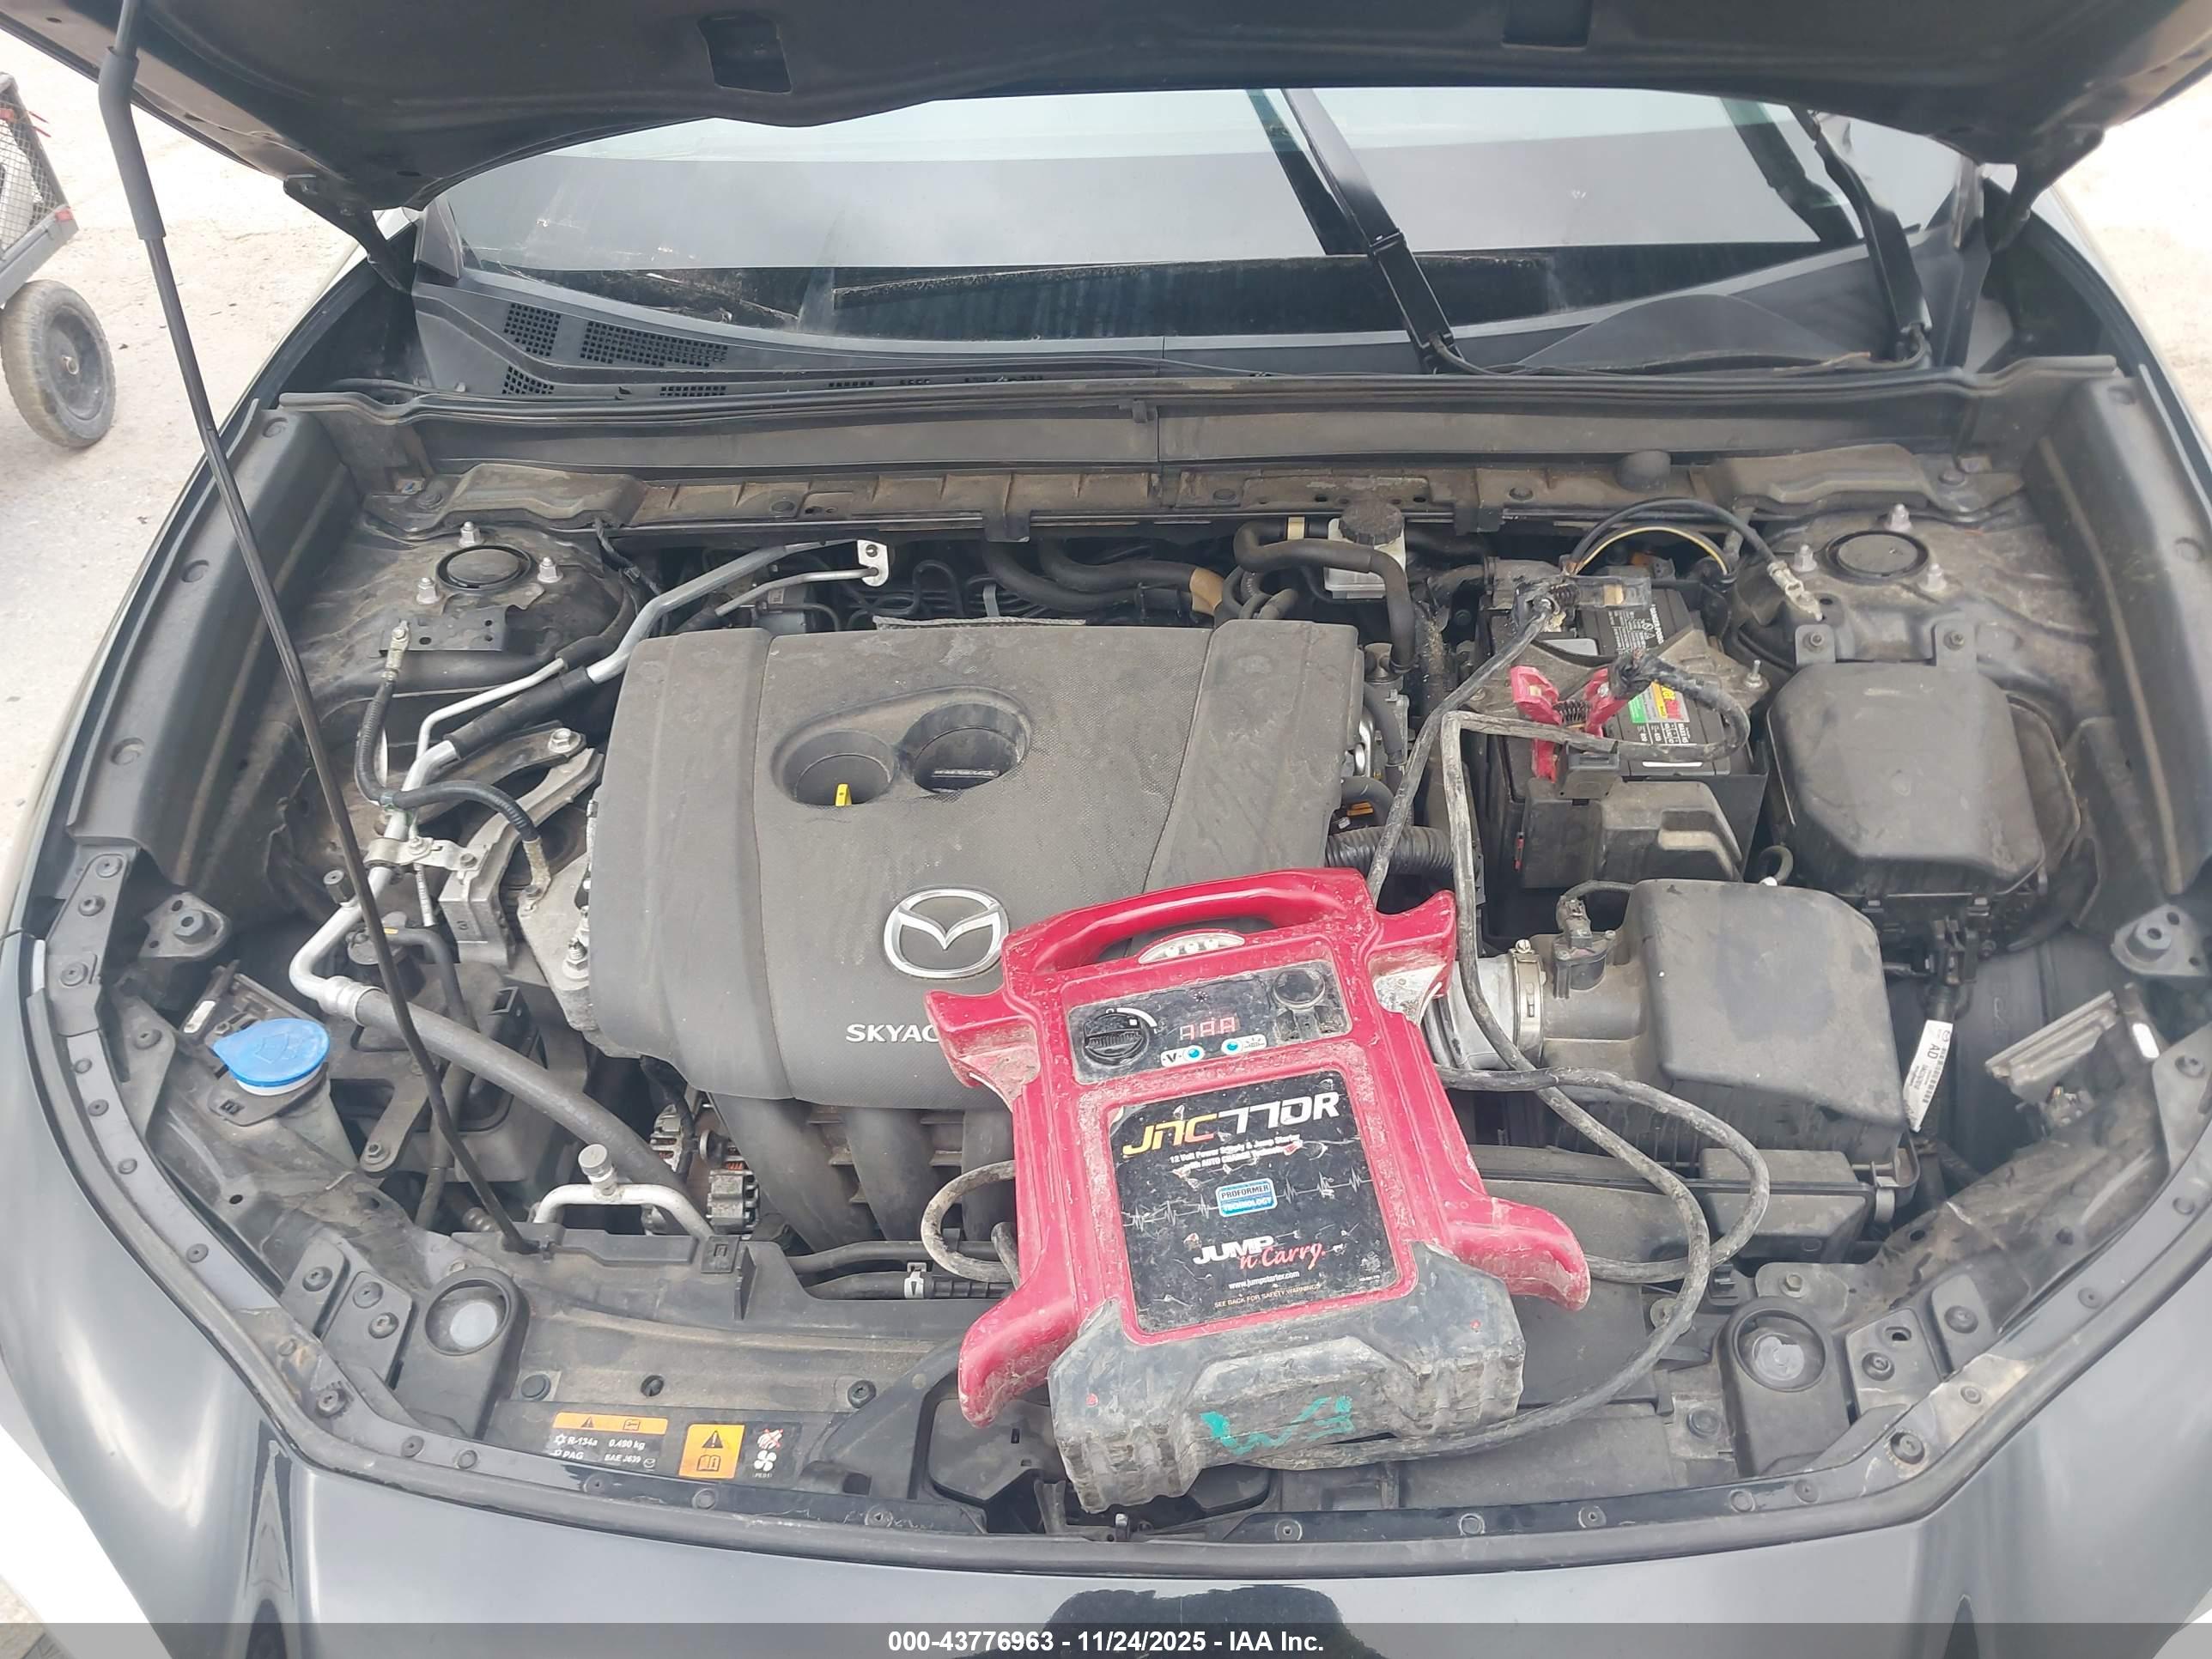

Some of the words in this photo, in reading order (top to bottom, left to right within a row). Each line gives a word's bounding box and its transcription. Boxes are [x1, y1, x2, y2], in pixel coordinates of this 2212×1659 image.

[1928, 1043, 1940, 1060] AD
[1170, 1154, 1181, 1164] 12
[1180, 1152, 1195, 1161] Volt
[1195, 1148, 1219, 1159] Power
[1246, 1141, 1253, 1150] &
[1254, 1139, 1274, 1149] Jump
[1274, 1133, 1301, 1145] Starter
[1201, 1156, 1221, 1167] AUTO
[1221, 1184, 1269, 1200] PROFORMER
[1192, 1235, 1274, 1265] JUMP
[1228, 1271, 1300, 1290] www.jumpstarter.com
[1214, 1300, 1228, 1309] SEE
[1228, 1297, 1246, 1306] BACK
[1247, 1294, 1261, 1303] FOR
[1261, 1290, 1286, 1300] SAFETY
[567, 1436, 599, 1446] R-134a
[633, 1439, 646, 1451] kg
[562, 1449, 584, 1460] PAG
